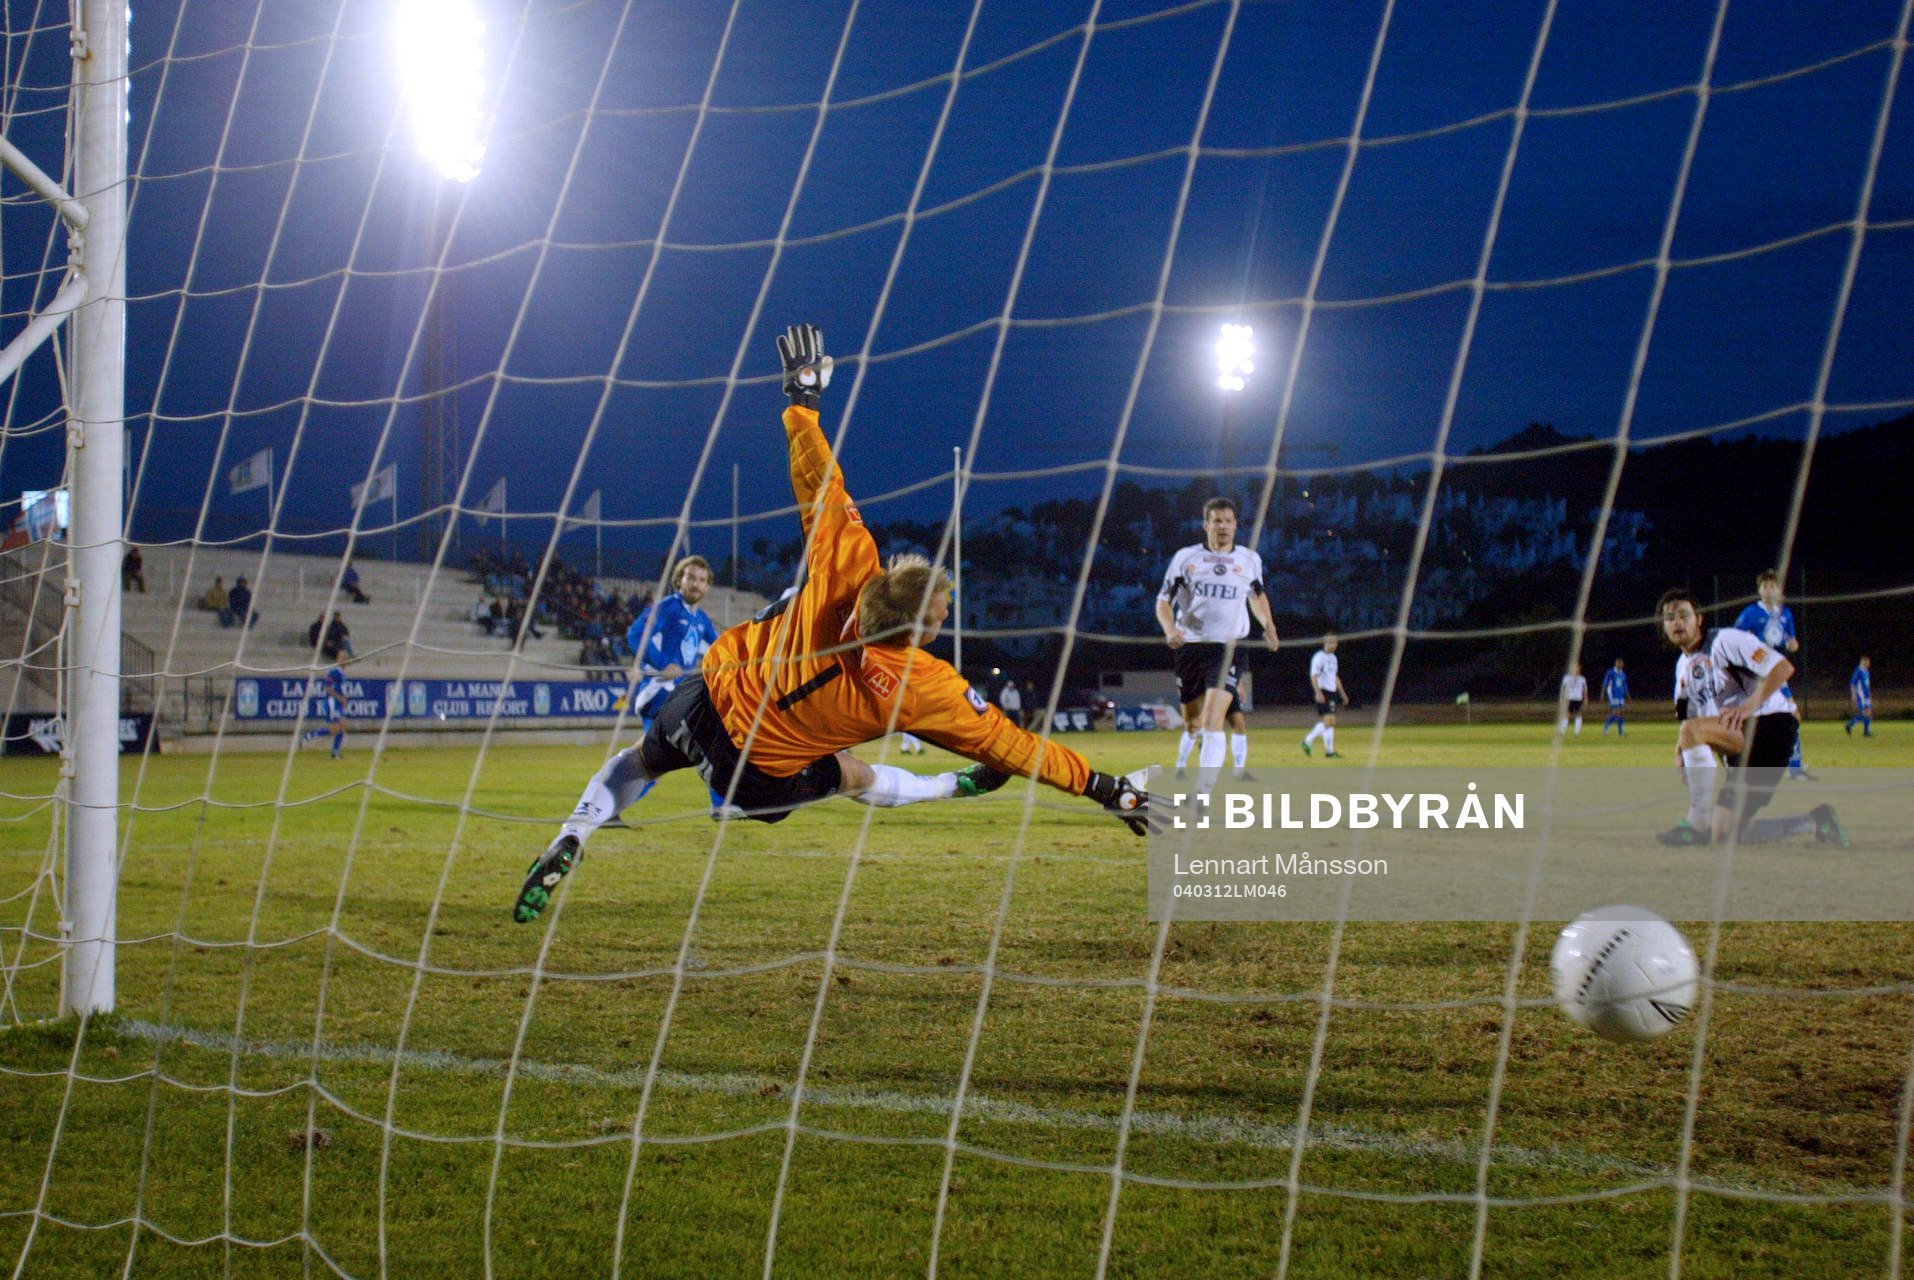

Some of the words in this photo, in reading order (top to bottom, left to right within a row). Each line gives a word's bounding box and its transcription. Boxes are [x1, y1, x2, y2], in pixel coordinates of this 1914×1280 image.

[282, 681, 302, 698] LA
[309, 681, 364, 698] MGA
[446, 683, 465, 698] LA
[316, 701, 378, 716] RORT
[433, 701, 470, 716] CLUB
